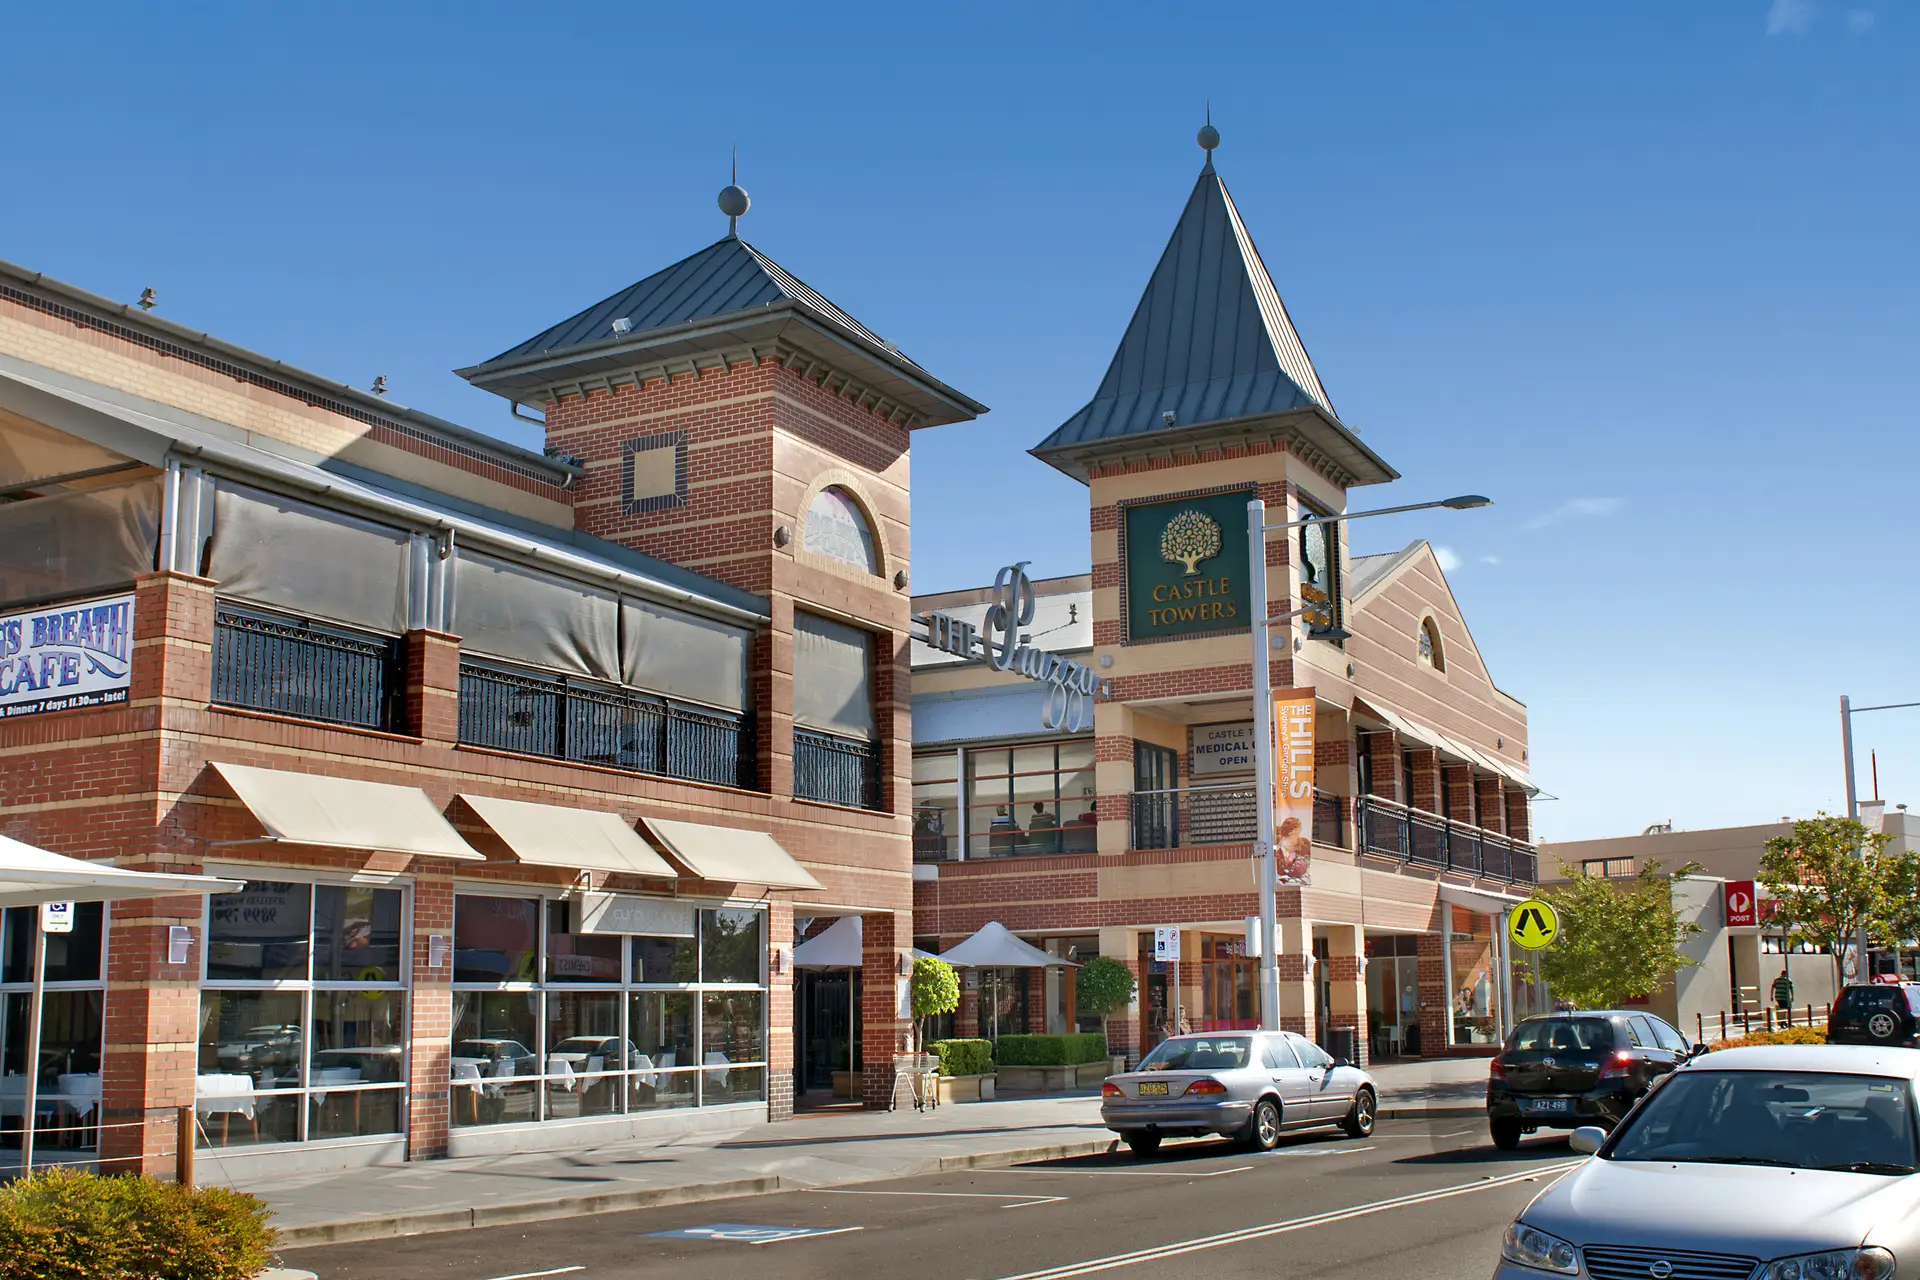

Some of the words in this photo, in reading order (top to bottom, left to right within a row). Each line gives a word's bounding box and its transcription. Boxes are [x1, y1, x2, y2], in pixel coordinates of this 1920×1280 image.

[1153, 577, 1230, 602] CASTLE
[1148, 601, 1237, 626] TOWERS
[30, 602, 130, 664] BREATH
[928, 610, 977, 656] THE
[0, 651, 80, 696] CAFE
[7, 704, 37, 716] Dinner
[39, 701, 46, 711] 7
[47, 700, 67, 711] days
[104, 691, 126, 702] late!
[1290, 705, 1311, 715] THE
[1208, 729, 1244, 740] CASTLE
[1196, 741, 1249, 754] MEDICAL
[1281, 743, 1289, 774] Garden
[1289, 717, 1312, 798] HILLS
[1220, 756, 1248, 765] OPEN
